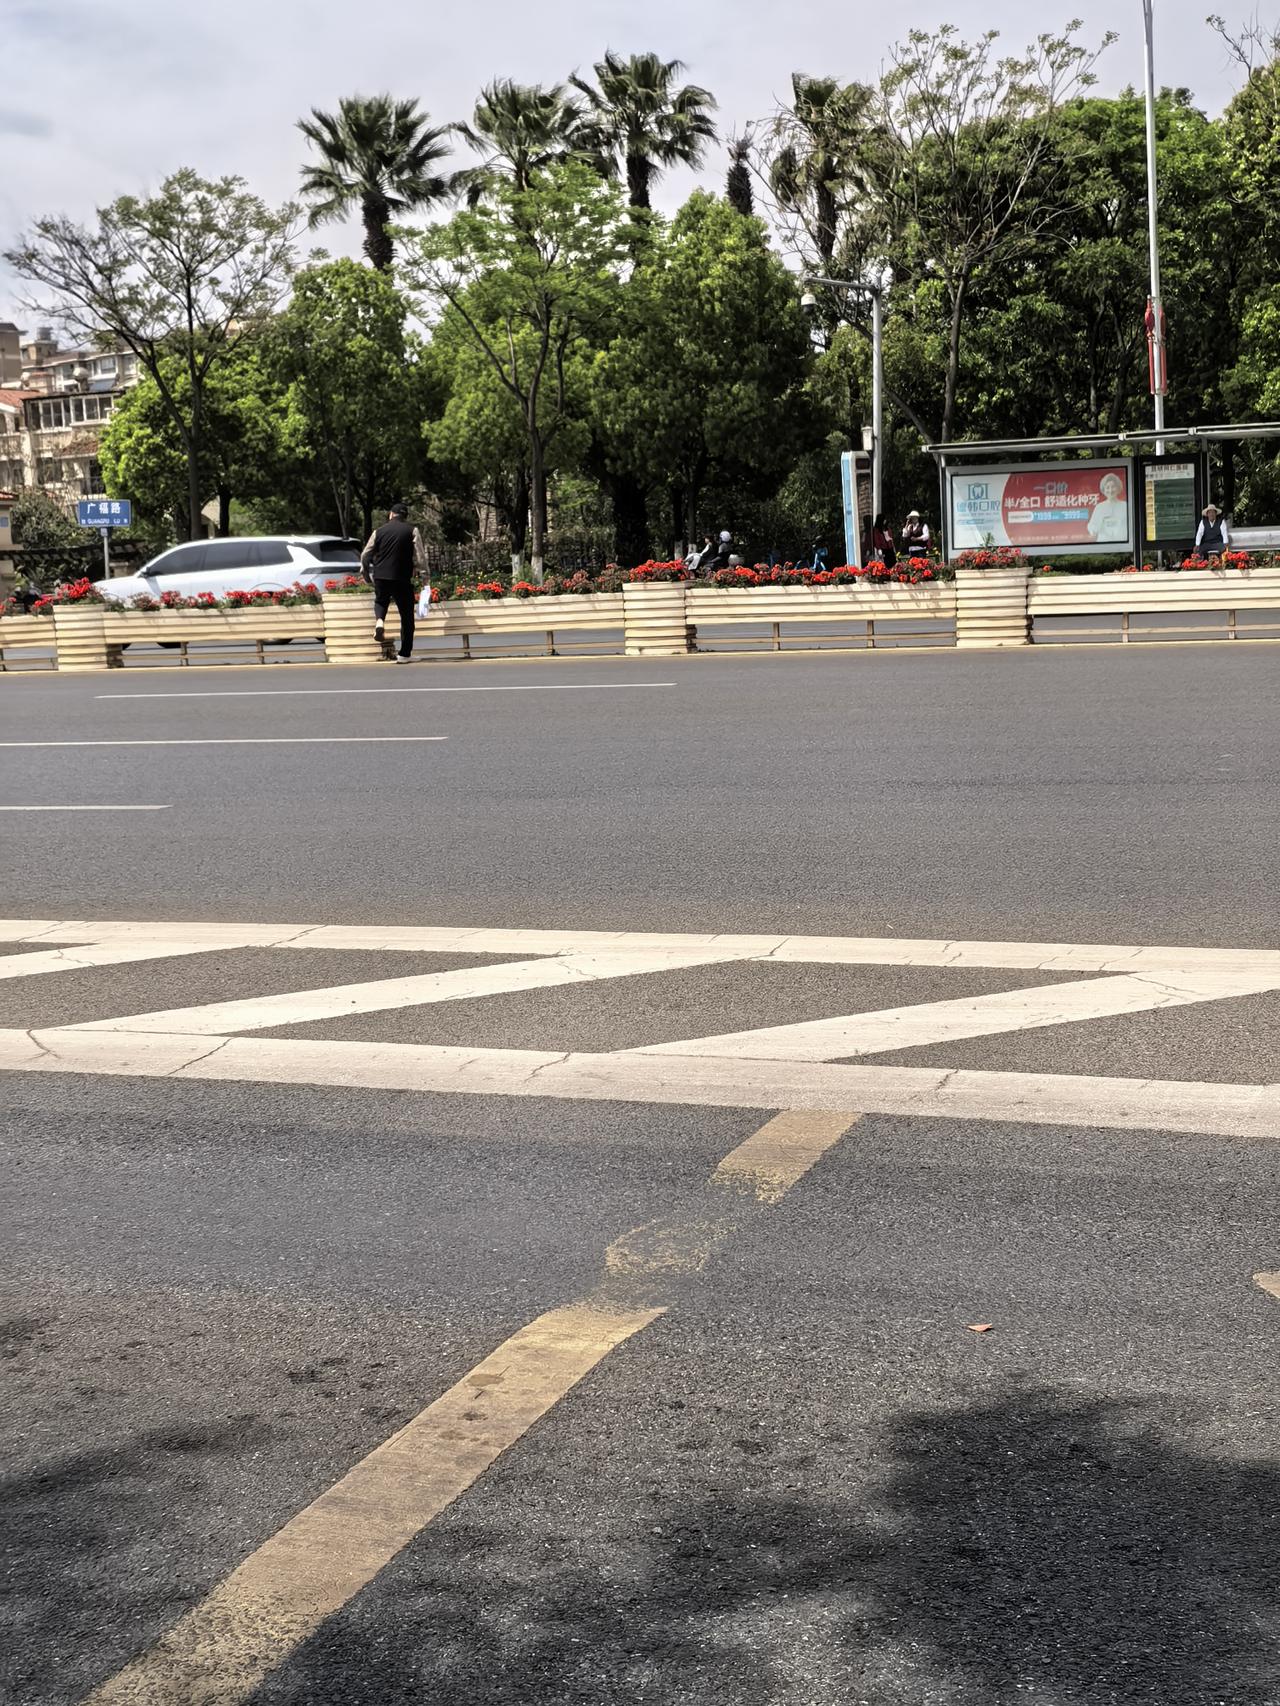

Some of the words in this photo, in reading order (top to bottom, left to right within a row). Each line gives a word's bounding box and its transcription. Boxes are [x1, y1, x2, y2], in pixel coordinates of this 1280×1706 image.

[87, 502, 121, 514] 广福路
[1005, 496, 1041, 509] 半/全口
[1045, 493, 1100, 508] 舒适化种牙
